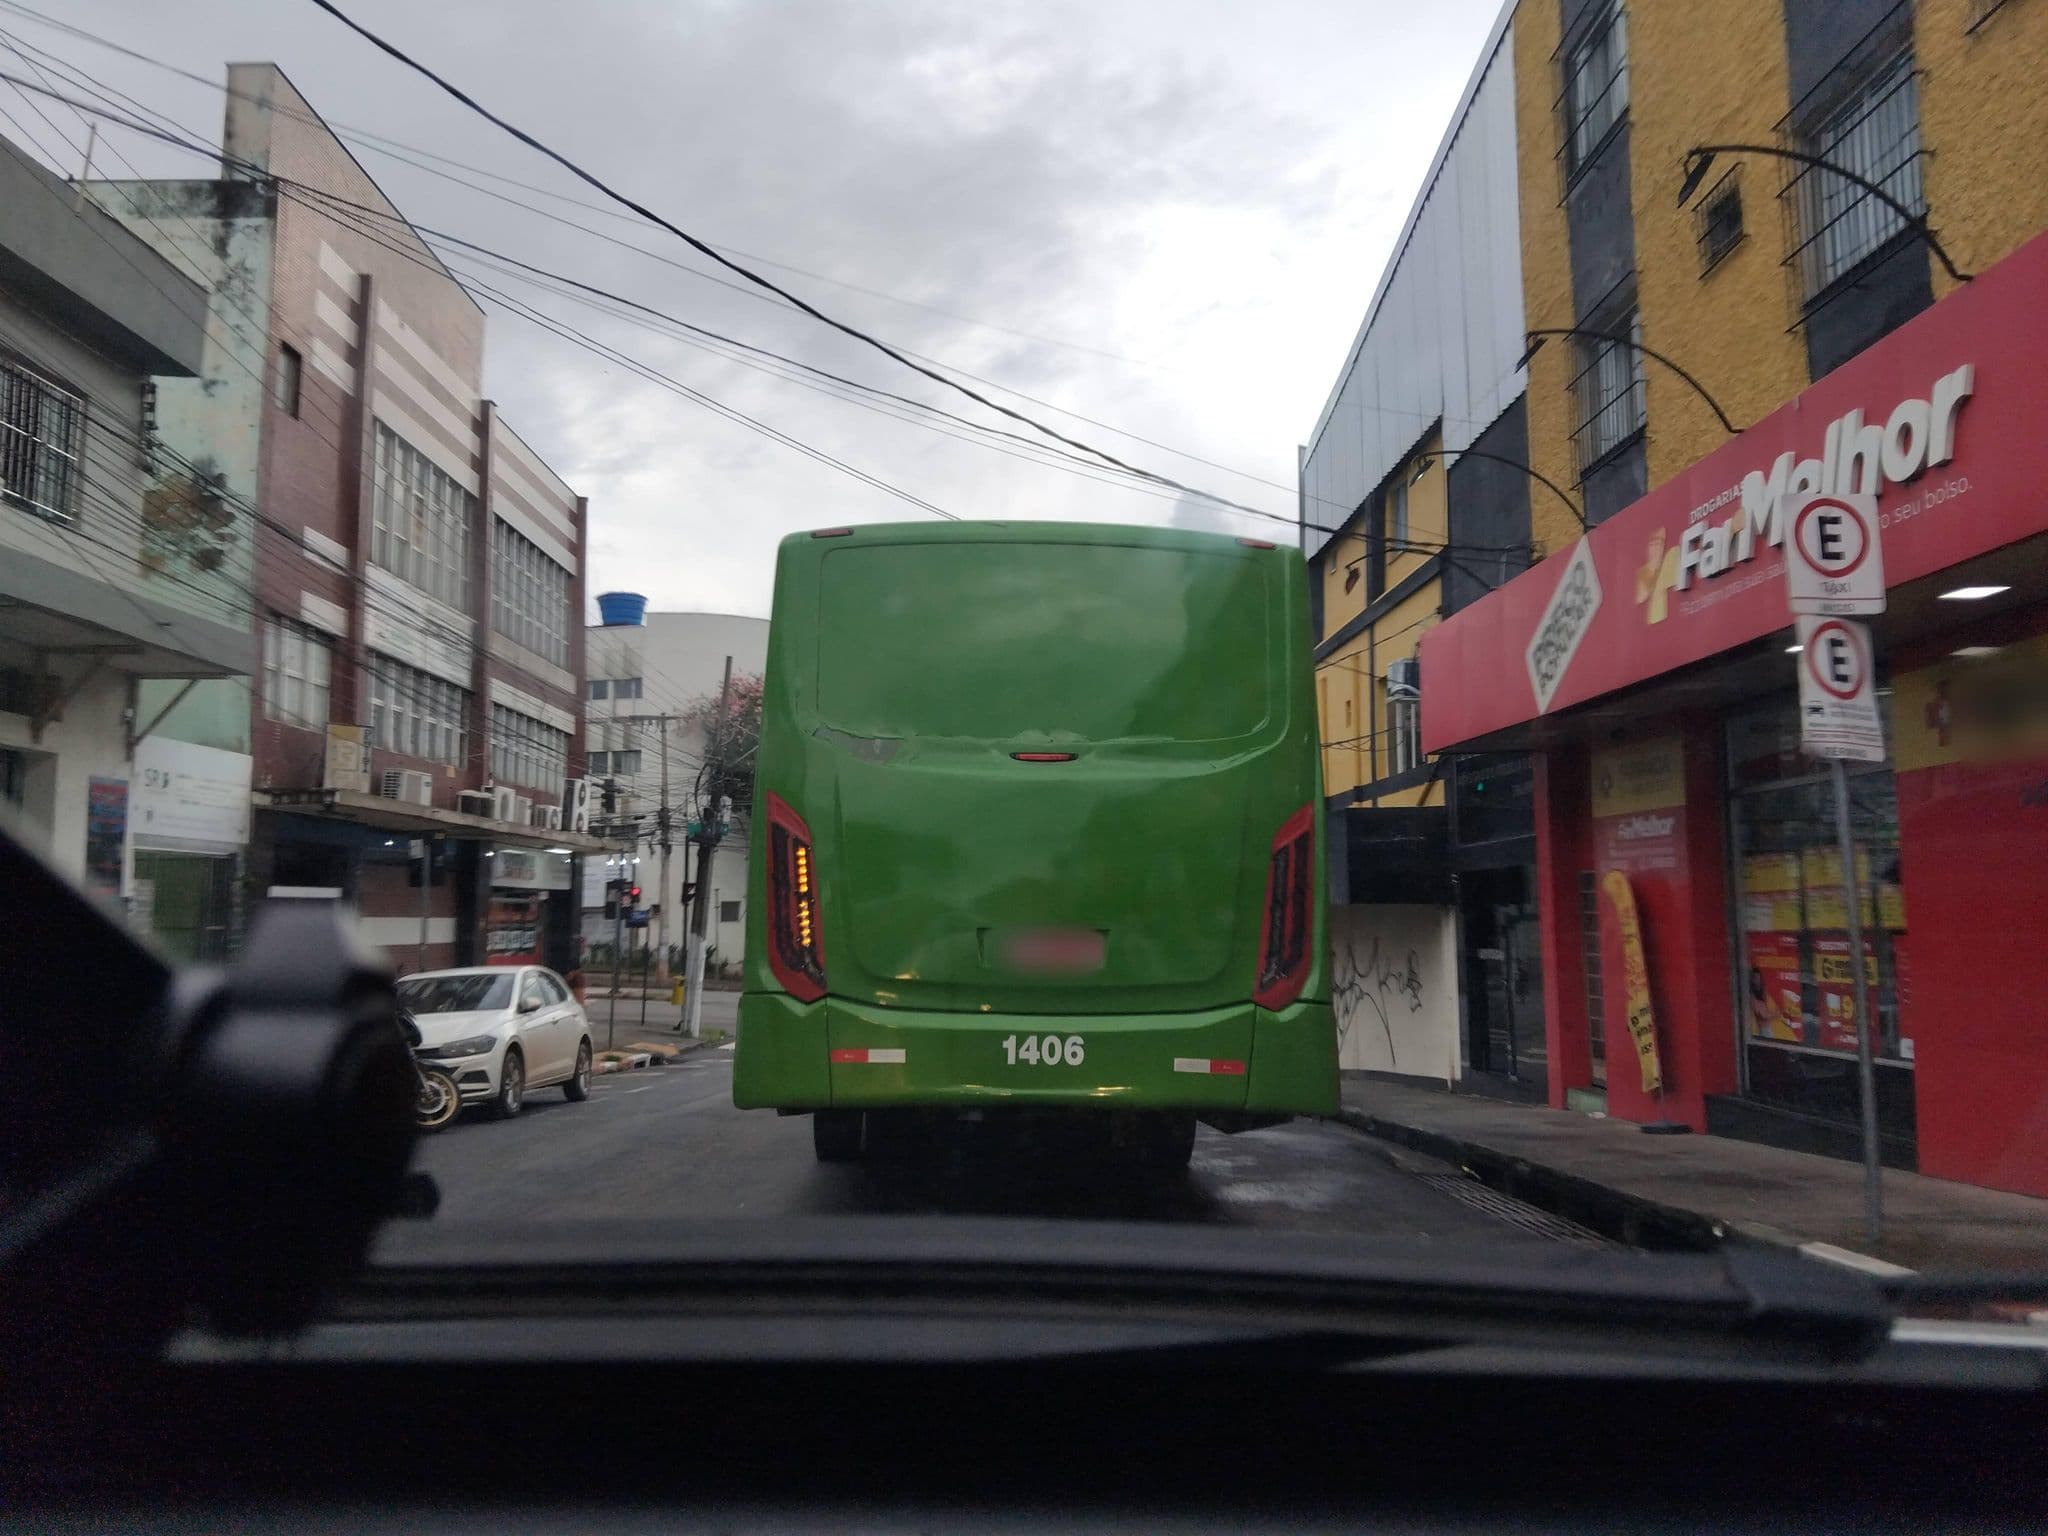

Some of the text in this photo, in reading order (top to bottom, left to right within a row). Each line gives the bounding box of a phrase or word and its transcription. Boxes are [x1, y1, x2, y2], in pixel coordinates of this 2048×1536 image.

[1894, 500, 1922, 523] seu
[1926, 476, 1973, 509] bolso.
[1817, 515, 1846, 560] E
[1824, 637, 1850, 683] E
[1002, 1034, 1085, 1066] 1406
